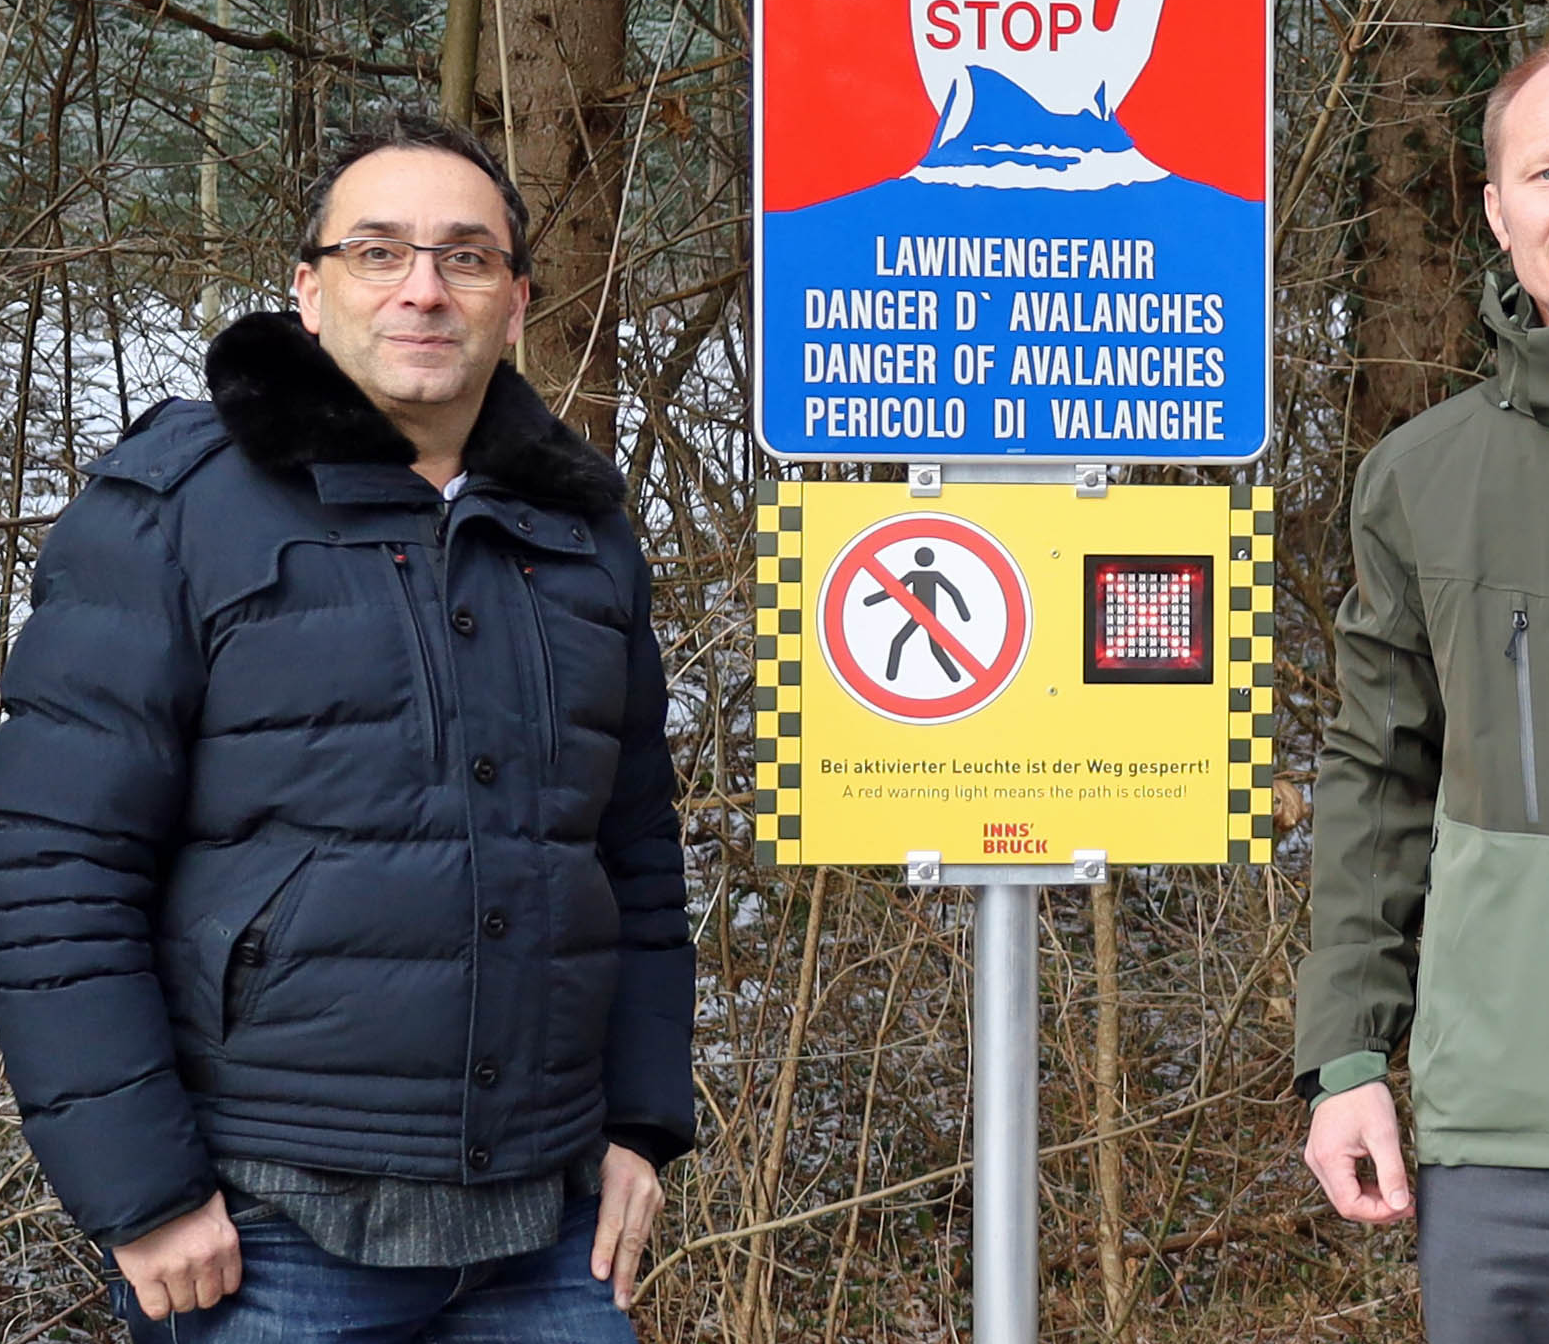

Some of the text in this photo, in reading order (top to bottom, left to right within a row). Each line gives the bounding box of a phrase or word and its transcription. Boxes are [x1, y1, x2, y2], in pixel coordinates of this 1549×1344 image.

[875, 235, 1156, 280] LAWINENGEFAHR
[804, 288, 939, 331] DANGER
[1009, 291, 1225, 335] AVALANCHES
[803, 342, 1226, 388] DANGER OF AVALANCHES
[804, 396, 1225, 441] PERICOLO DI VALANGHE
[820, 758, 1210, 777] Bei aktivierter Leuchte ist der Weg gesperrt!
[842, 784, 1188, 801] A red warning light means the path is closed!
[983, 839, 1048, 854] BRUCK
